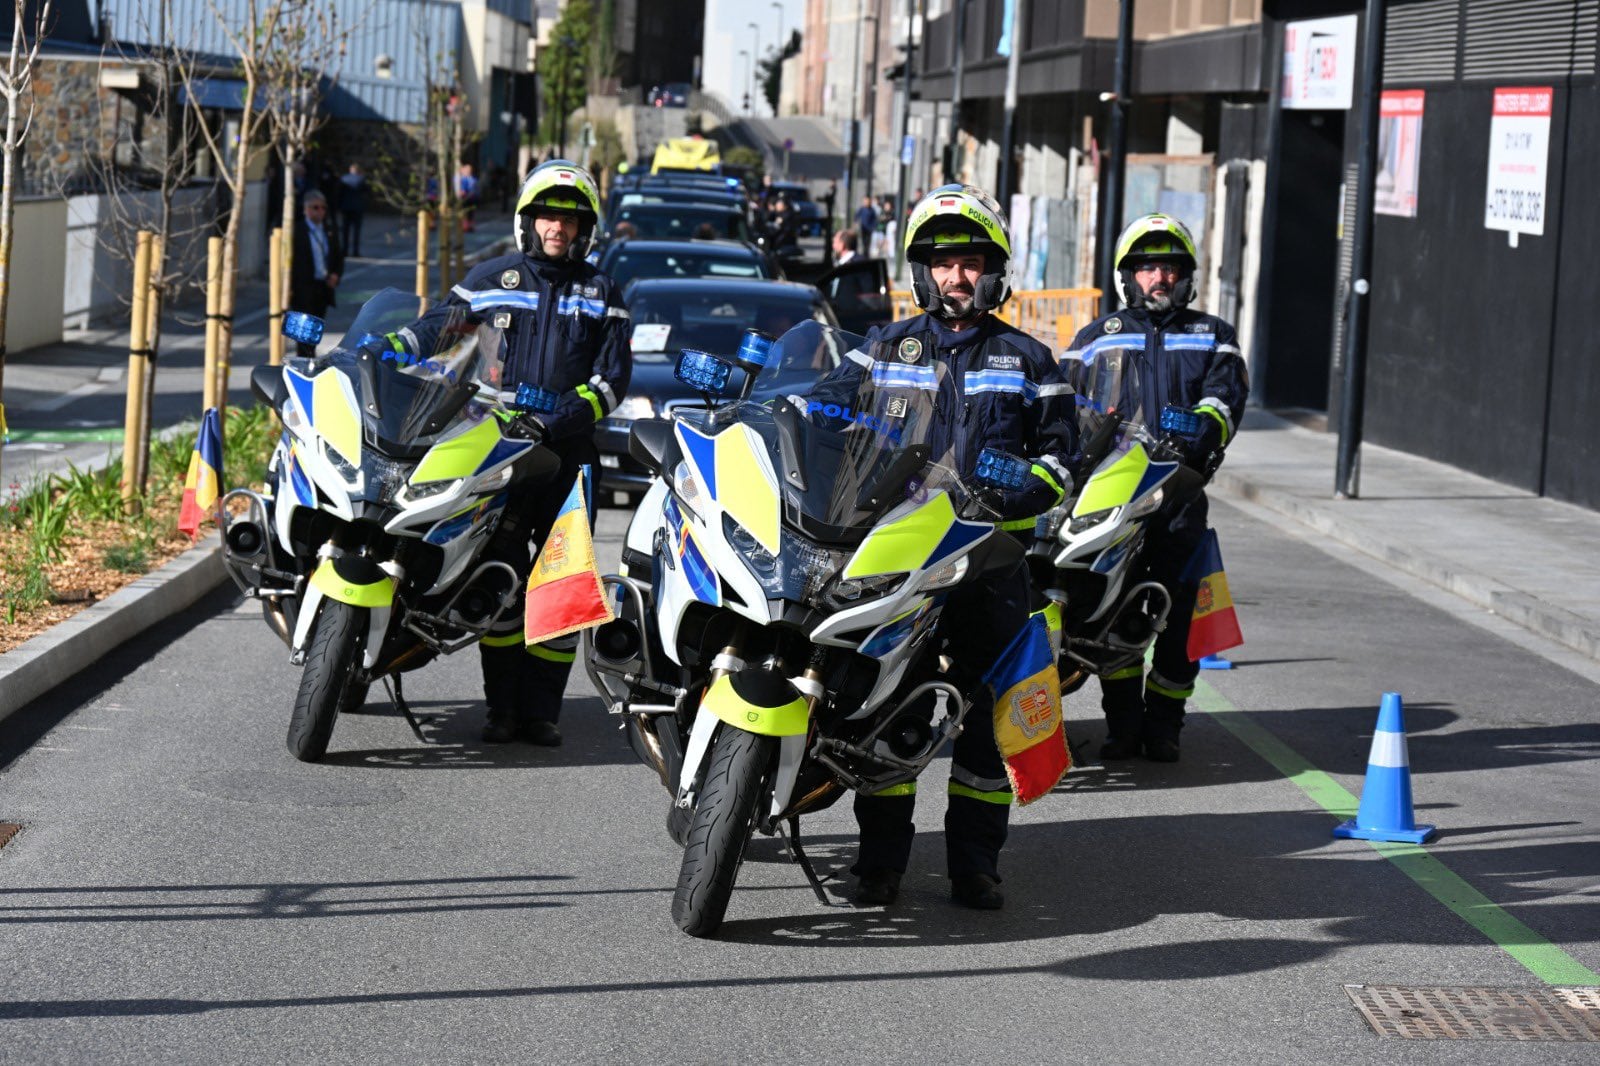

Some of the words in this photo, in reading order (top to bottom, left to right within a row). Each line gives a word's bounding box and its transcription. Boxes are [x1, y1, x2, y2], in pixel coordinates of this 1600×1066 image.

[968, 207, 994, 230] POLICIA
[382, 350, 457, 383] POLICIA
[988, 355, 1020, 365] POLICIA
[806, 401, 902, 444] POLICIA
